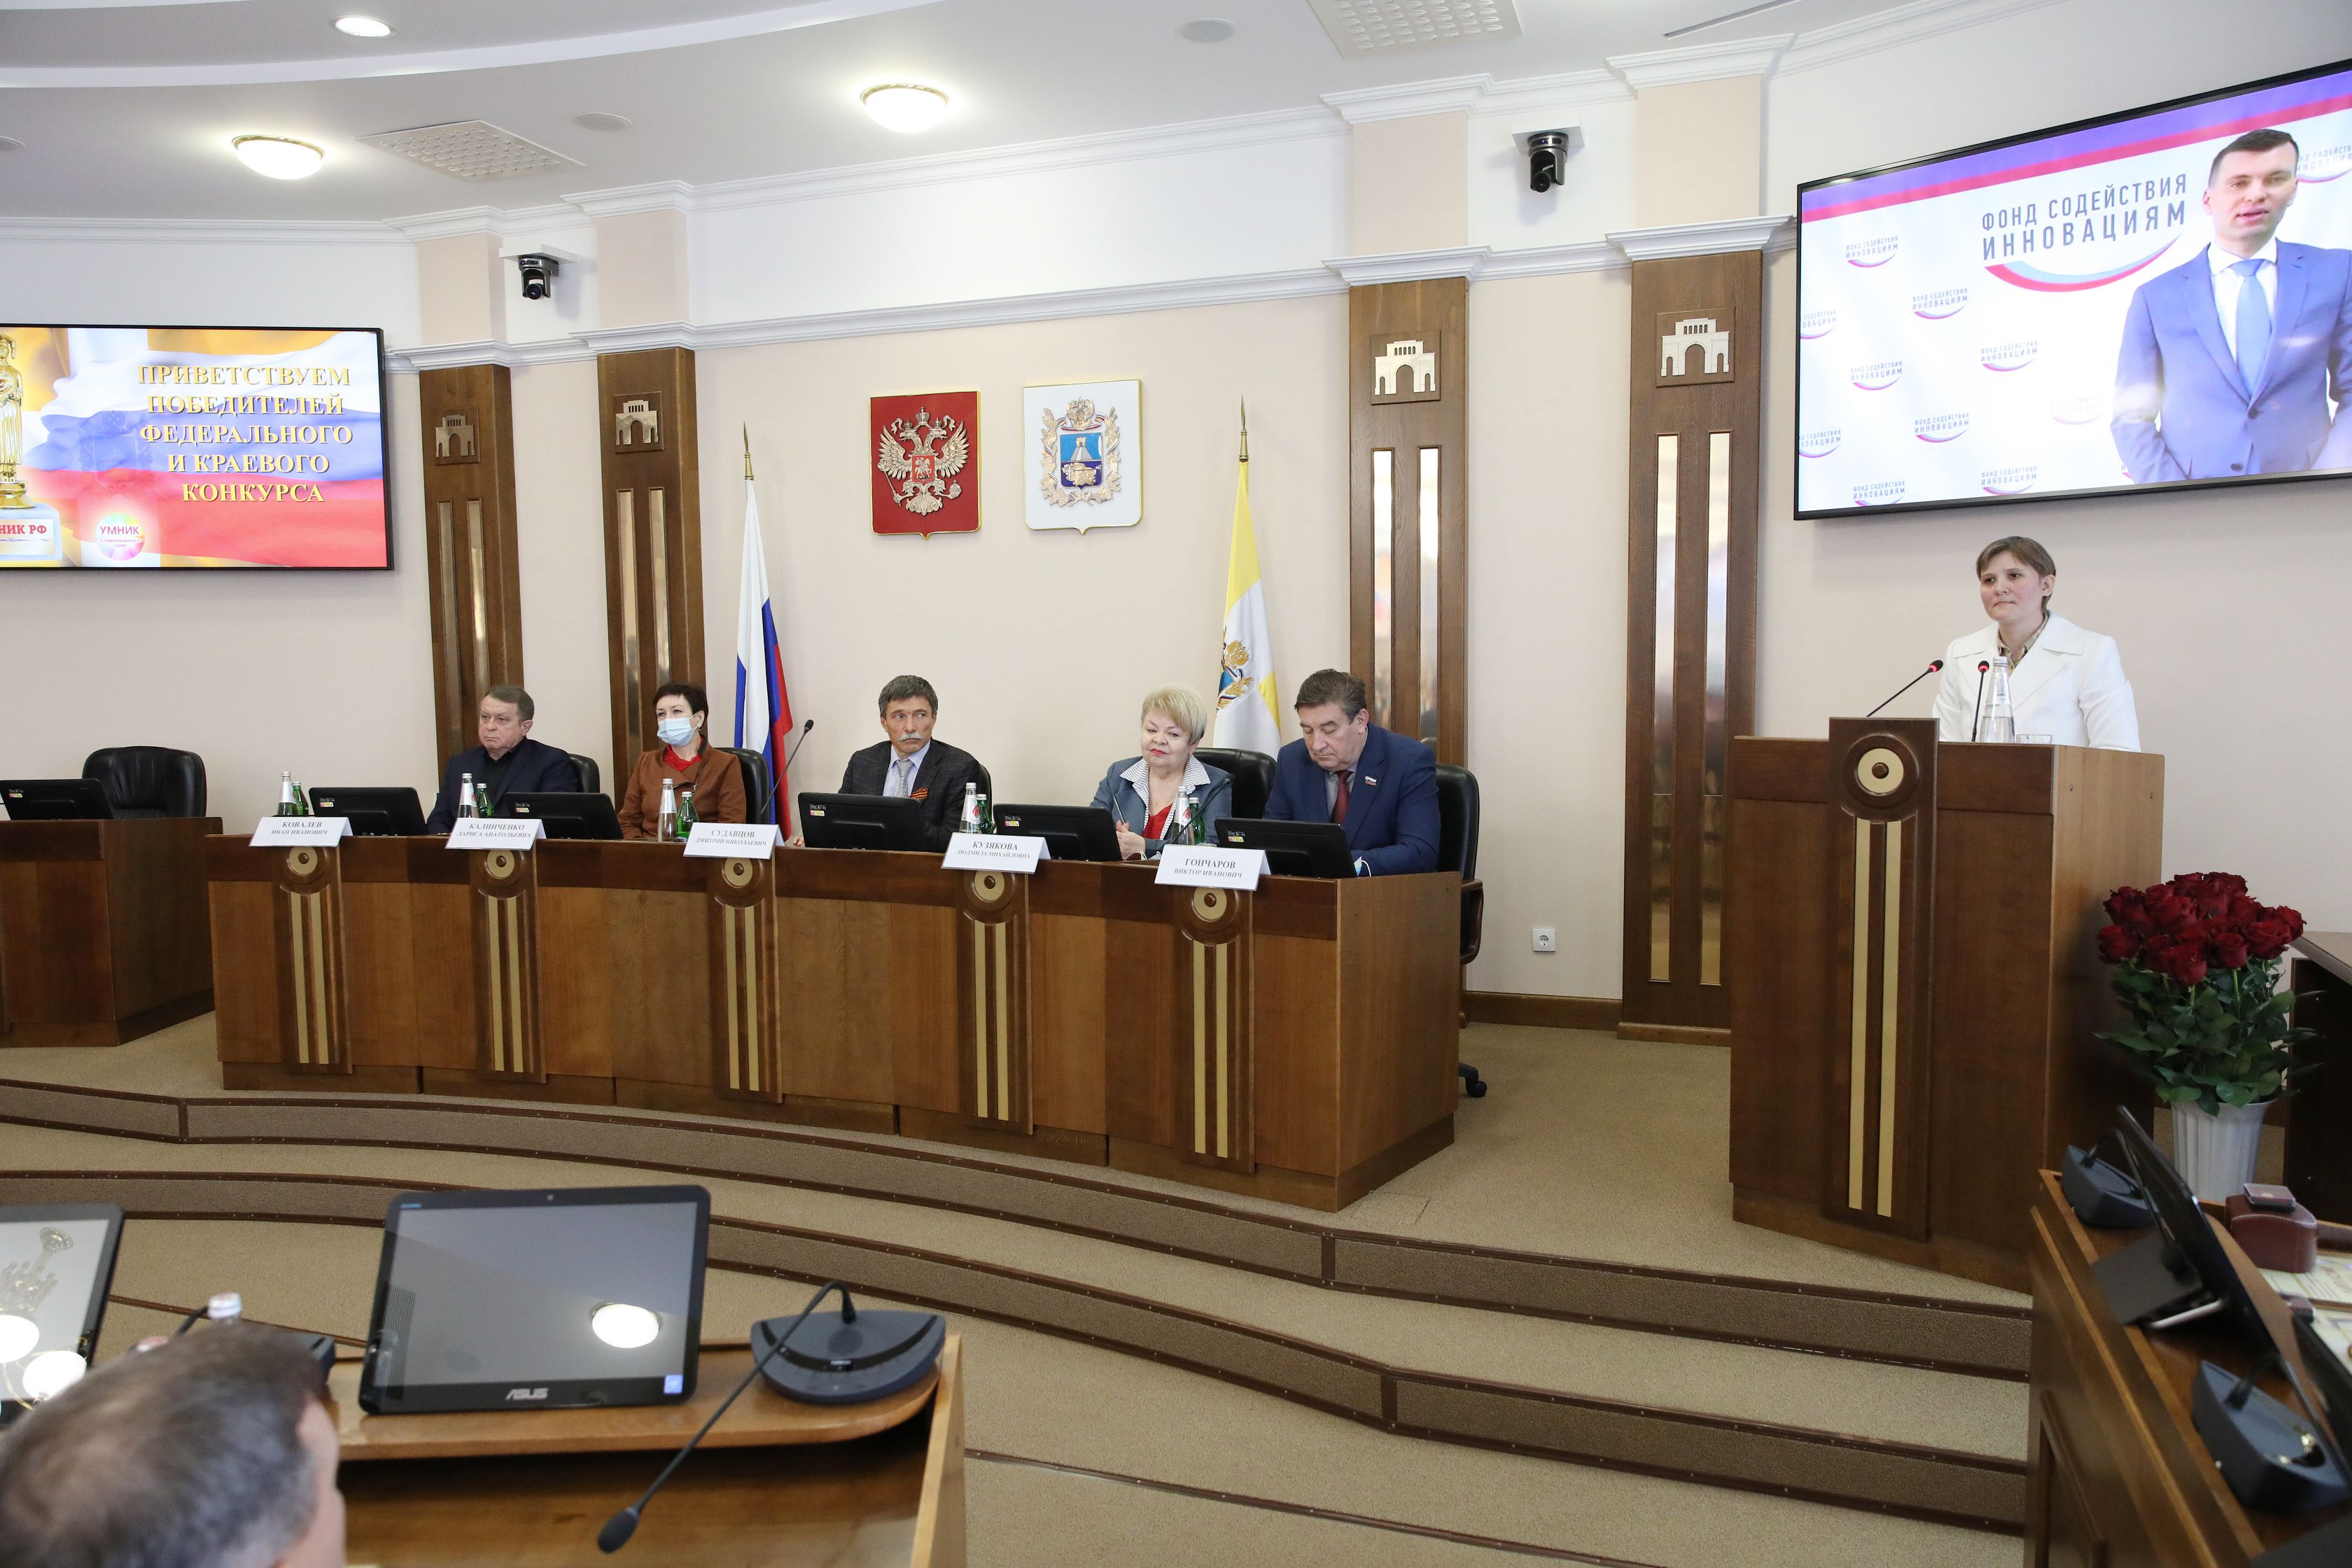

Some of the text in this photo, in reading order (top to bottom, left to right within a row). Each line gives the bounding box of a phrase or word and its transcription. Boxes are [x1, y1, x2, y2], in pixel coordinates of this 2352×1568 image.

[1982, 173, 2186, 231] ФОНД СОДЕЙСТВИЯ
[1982, 200, 2185, 260] ИННОВАЦИЯМ
[1863, 235, 1898, 248] СОДЕЙСТВИЯ
[1846, 243, 1898, 259] ИННОВАЦИЯМ
[1912, 288, 1968, 302] ФОНД СОДЕЙСТВИЯ
[1912, 295, 1968, 310] ИННОВАЦИЯМ
[138, 365, 351, 386] ПРИВЕТСТВУЕМ
[146, 393, 344, 416] ПОБЕДИТЕЛЕЙ
[1933, 412, 1969, 424] СОДЕЙСТВИЯ
[1914, 419, 1969, 433] ИННОВАЦИЯМ
[140, 425, 353, 447] ФЕДЕРАЛЬНОГО
[167, 454, 330, 474] И КРАЕВОГО
[1981, 472, 2037, 486] ИННОВАЦИЯМ
[181, 483, 326, 503] КОНКУРСА
[29, 524, 47, 534] РФ
[99, 526, 139, 535] УМНИК
[711, 830, 755, 838] СУДАВЦОВ
[973, 841, 1018, 850] КУЗЯКОВА
[1185, 858, 1236, 869] ГОНЧАРОВ
[505, 1387, 549, 1400] ASUS
